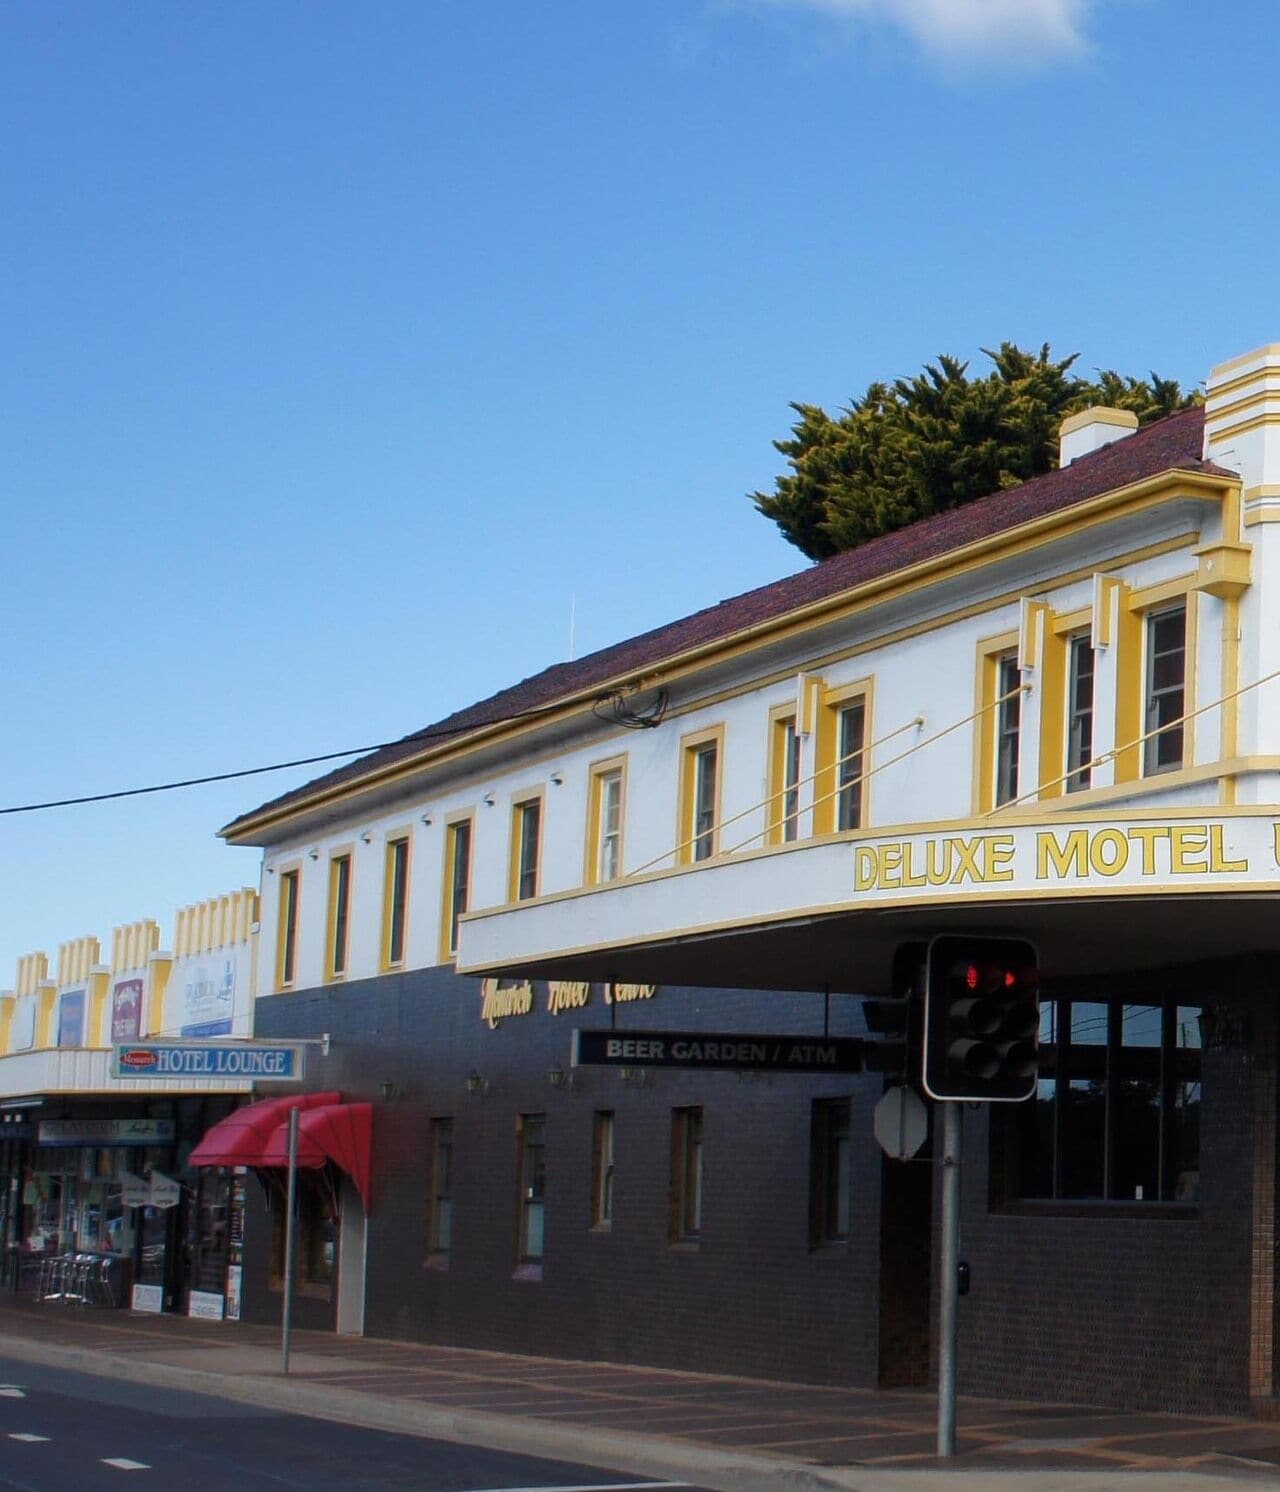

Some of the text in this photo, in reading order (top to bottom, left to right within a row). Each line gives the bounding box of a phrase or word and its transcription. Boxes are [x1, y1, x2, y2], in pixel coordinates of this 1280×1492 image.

[854, 833, 1014, 892] DELUXE
[1036, 823, 1248, 879] MOTEL
[156, 1050, 284, 1073] HOTEL LOUNGE
[606, 1039, 664, 1060] BEER
[671, 1041, 767, 1062] GARDEN
[788, 1045, 837, 1064] ATM
